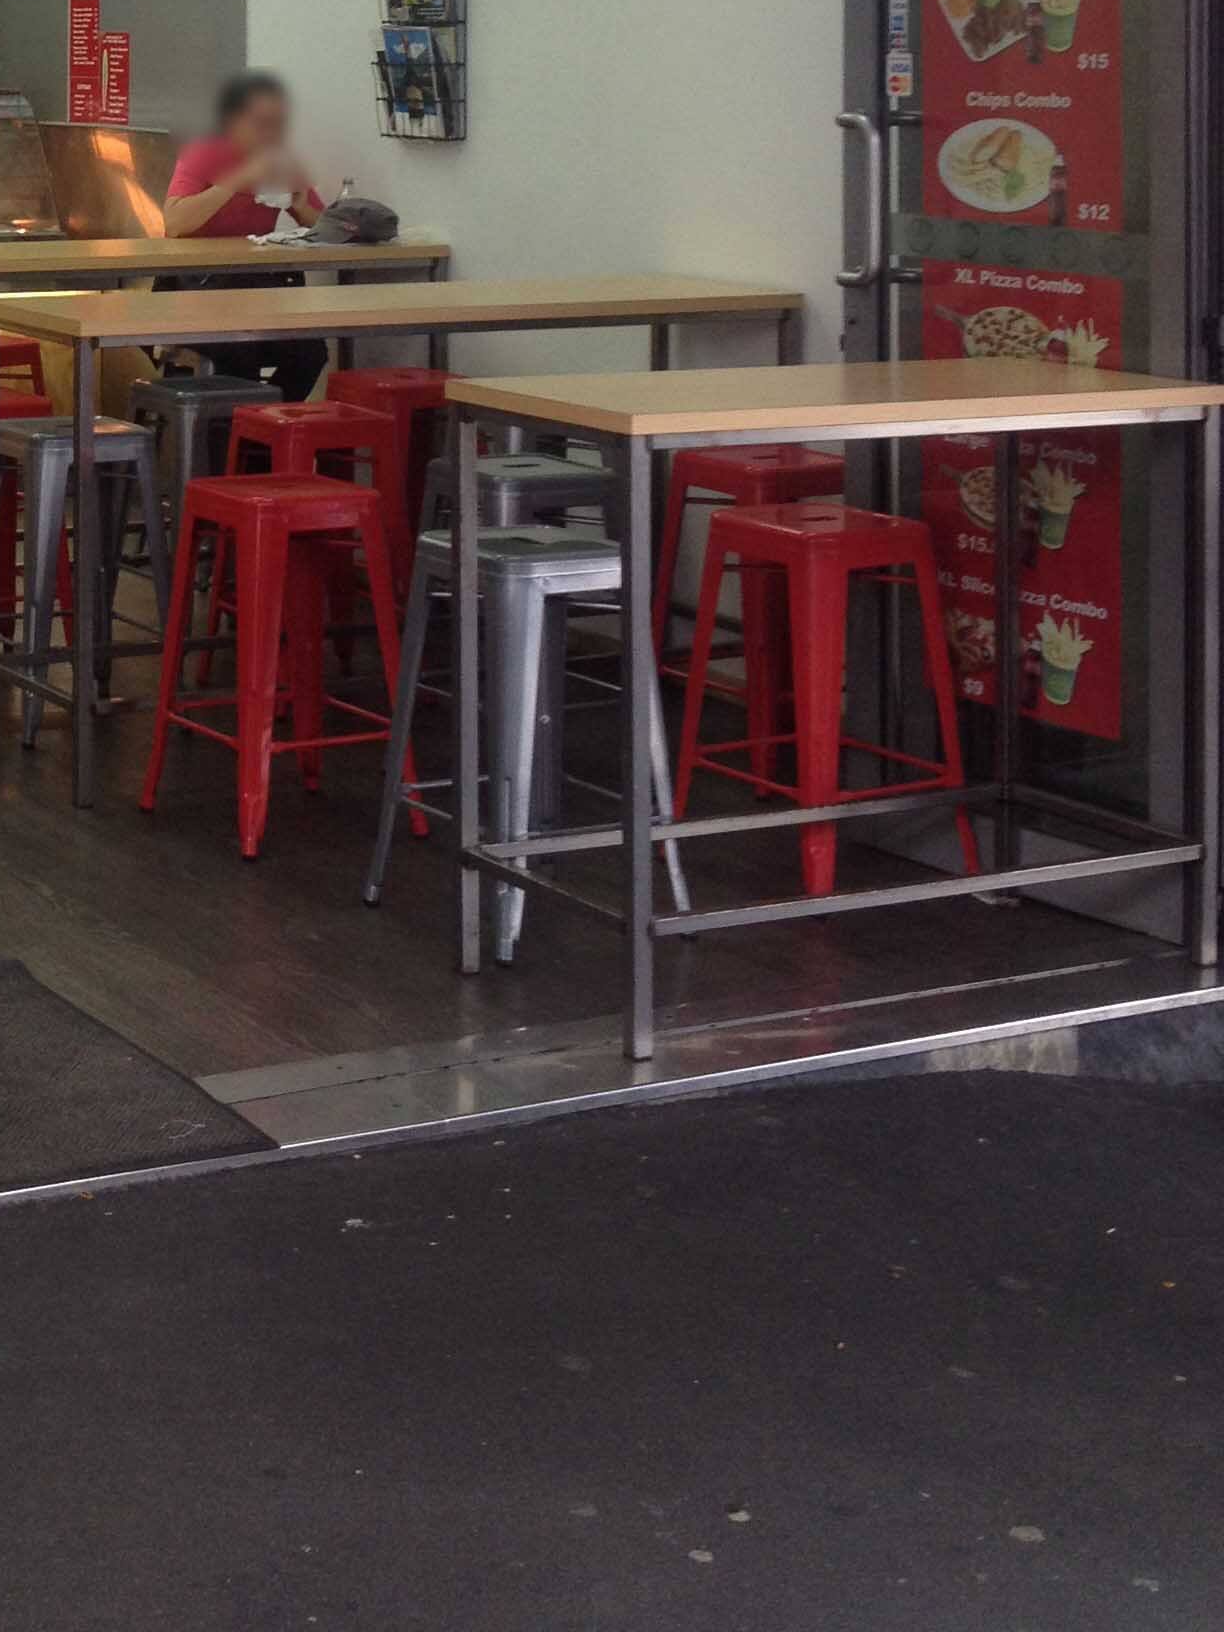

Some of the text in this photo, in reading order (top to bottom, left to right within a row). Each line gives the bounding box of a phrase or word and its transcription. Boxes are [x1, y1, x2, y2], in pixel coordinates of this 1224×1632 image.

[1077, 53, 1109, 71] $15
[966, 92, 1071, 110] Chips Combo
[1078, 204, 1110, 220] $12
[954, 268, 1086, 295] XL Pizza Combo
[1039, 442, 1097, 465] Combo
[1049, 593, 1109, 620] Combo
